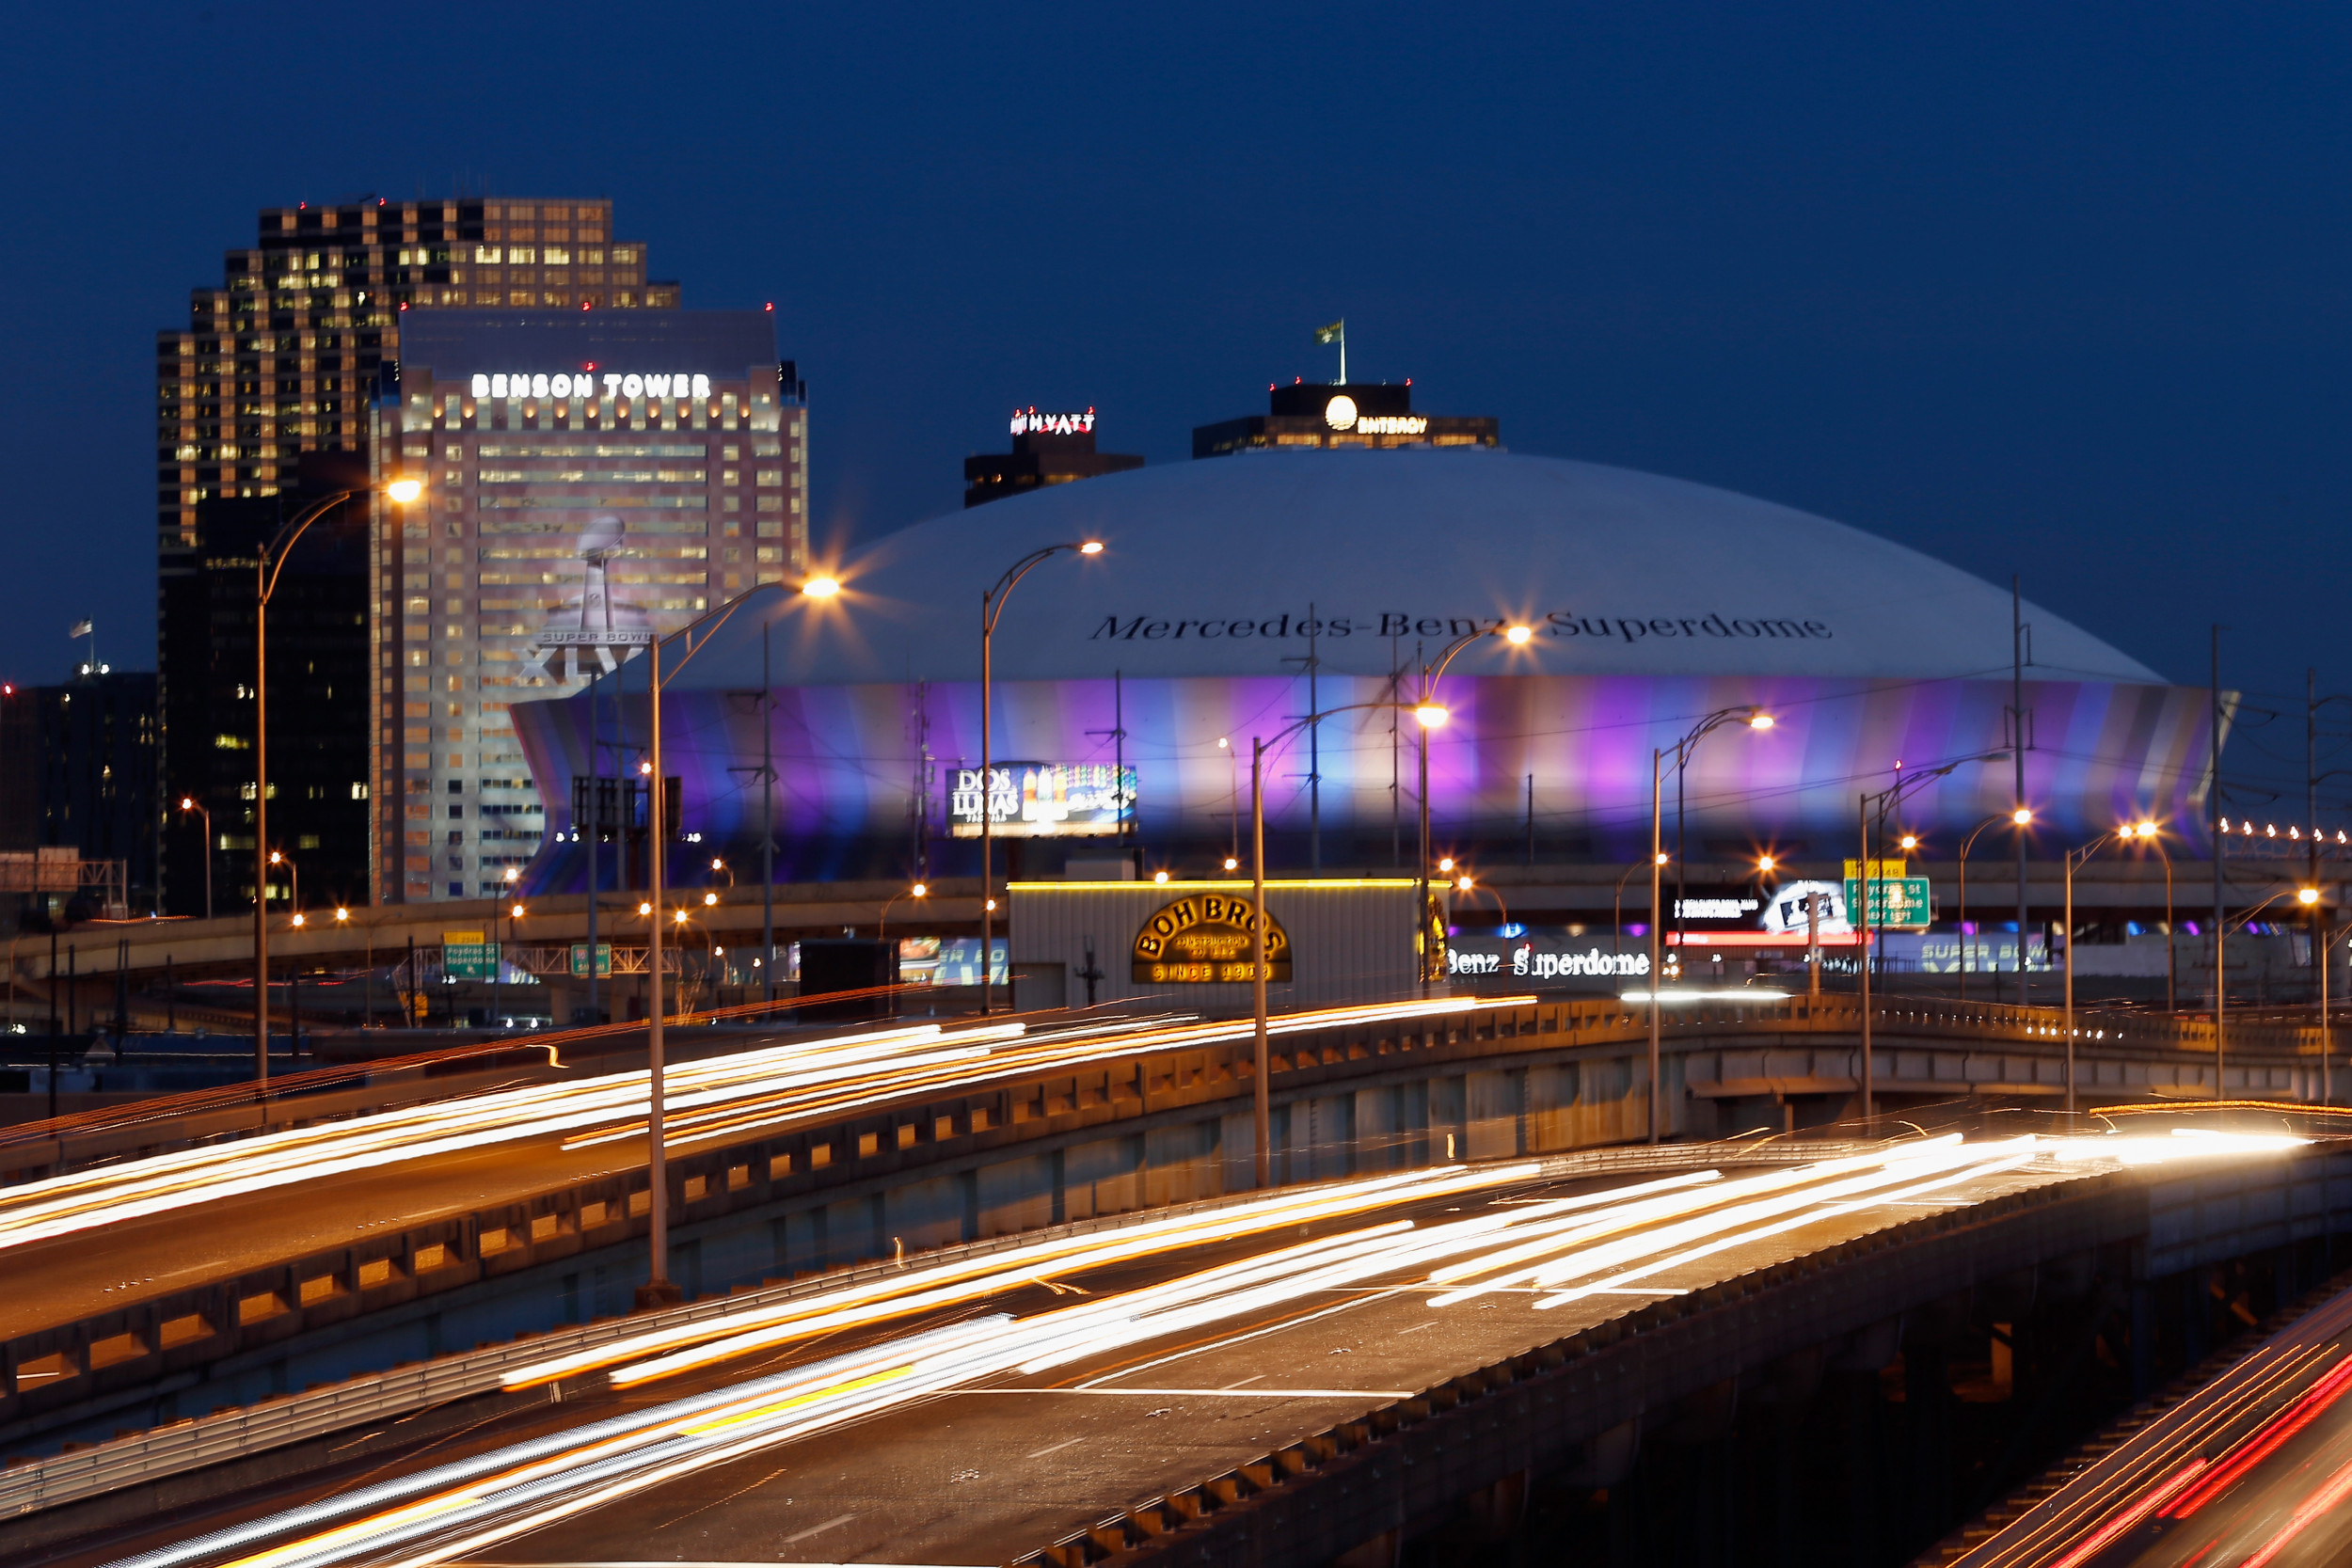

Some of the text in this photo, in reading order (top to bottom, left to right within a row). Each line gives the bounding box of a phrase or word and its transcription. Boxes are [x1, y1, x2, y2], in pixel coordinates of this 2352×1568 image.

[471, 373, 711, 398] BENSON TOWER
[1028, 414, 1095, 435] HYATT
[1357, 417, 1427, 434] ENTERGY
[1089, 611, 1834, 643] Mercedes-Benz Superdome
[542, 633, 599, 642] SUPER
[958, 768, 1013, 791] DOS
[1908, 884, 1921, 895] St
[1136, 900, 1195, 958] BOH
[1922, 943, 1990, 959] SUPER
[1154, 967, 1211, 979] SINCE
